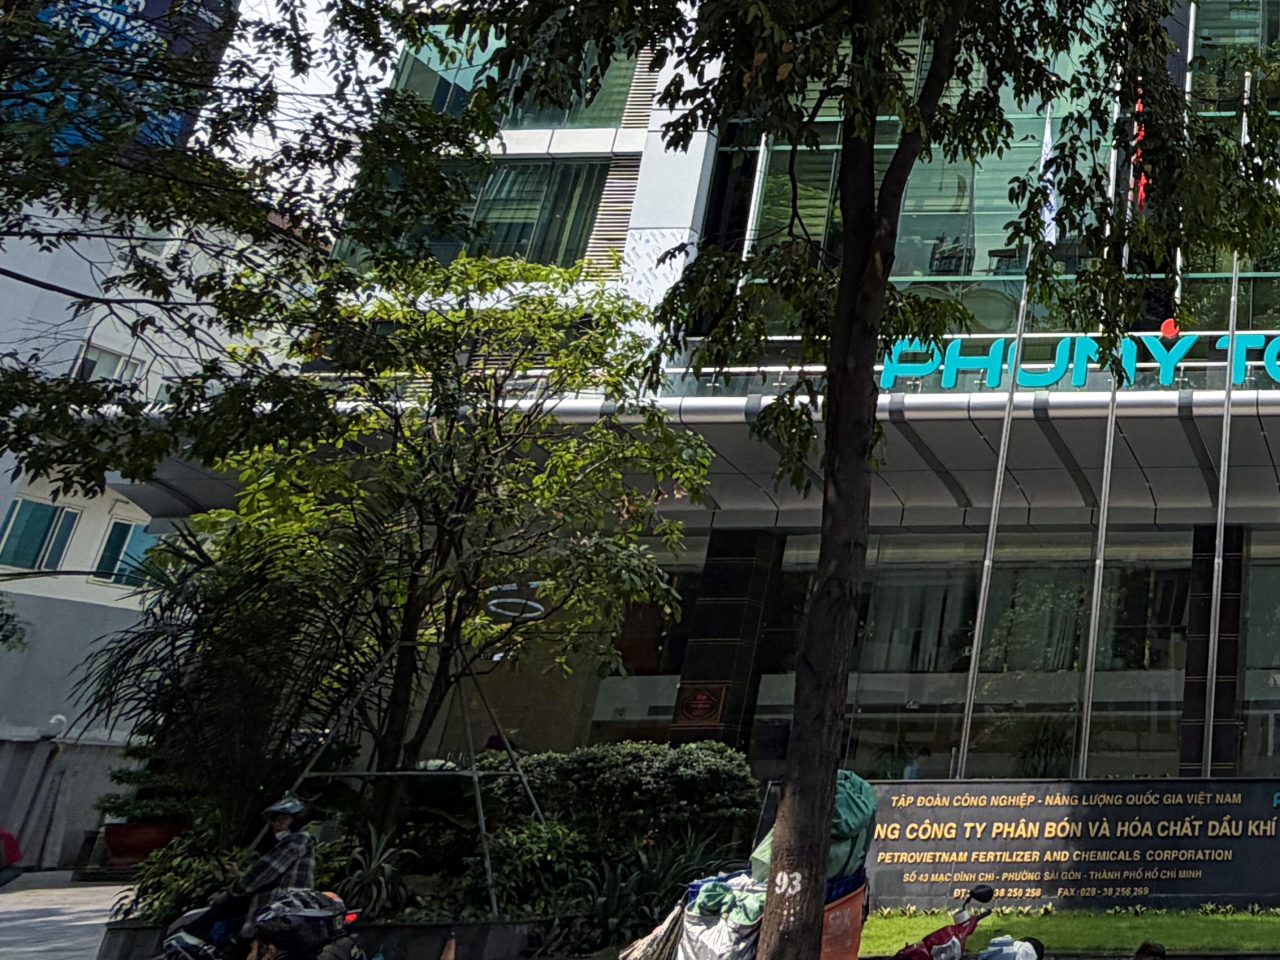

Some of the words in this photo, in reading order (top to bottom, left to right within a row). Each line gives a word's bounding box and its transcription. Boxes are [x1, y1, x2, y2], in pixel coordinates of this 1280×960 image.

[891, 794, 914, 809] TẬP
[916, 793, 950, 807] ĐOÀN
[953, 793, 987, 807] CÔNG
[990, 793, 1035, 809] NGHIỆP
[1045, 793, 1079, 806] NĂNG
[1082, 793, 1123, 808] LƯỢNG
[1126, 790, 1160, 805] QUỐC
[1163, 793, 1184, 805] GIA
[1187, 791, 1213, 807] VIỆT
[1215, 793, 1242, 805] NAM
[873, 823, 900, 841] NG
[905, 819, 957, 840] CÔNG
[963, 822, 987, 840] TY
[991, 818, 1040, 839] PHÂN
[1044, 817, 1082, 839] BÓN
[1088, 817, 1111, 837] VÀ
[1116, 816, 1153, 837] HÓA
[1157, 815, 1203, 837] CHẤT
[1207, 814, 1243, 836] DẦU
[1248, 816, 1278, 836] KHÍ
[877, 851, 968, 864] PETROVIETNAM
[971, 851, 1040, 863] FERTILIZER
[1044, 851, 1069, 862] AND
[1072, 850, 1141, 862] CHEMICALS
[1146, 849, 1233, 861] CORPORATION
[774, 871, 802, 895] 93
[903, 870, 917, 883] SỐ
[917, 874, 929, 882] 43
[930, 873, 952, 884] MẠC
[978, 872, 995, 881] CHI
[1001, 870, 1042, 882] PHƯỜNG
[1044, 869, 1059, 881] SÀI
[1061, 869, 1082, 881] GÒN
[1089, 868, 1121, 880] THÀNH
[1123, 867, 1143, 879] PHỐ
[1160, 868, 1177, 879] CHÍ
[1178, 870, 1202, 879] MINH
[993, 888, 1004, 897] 38
